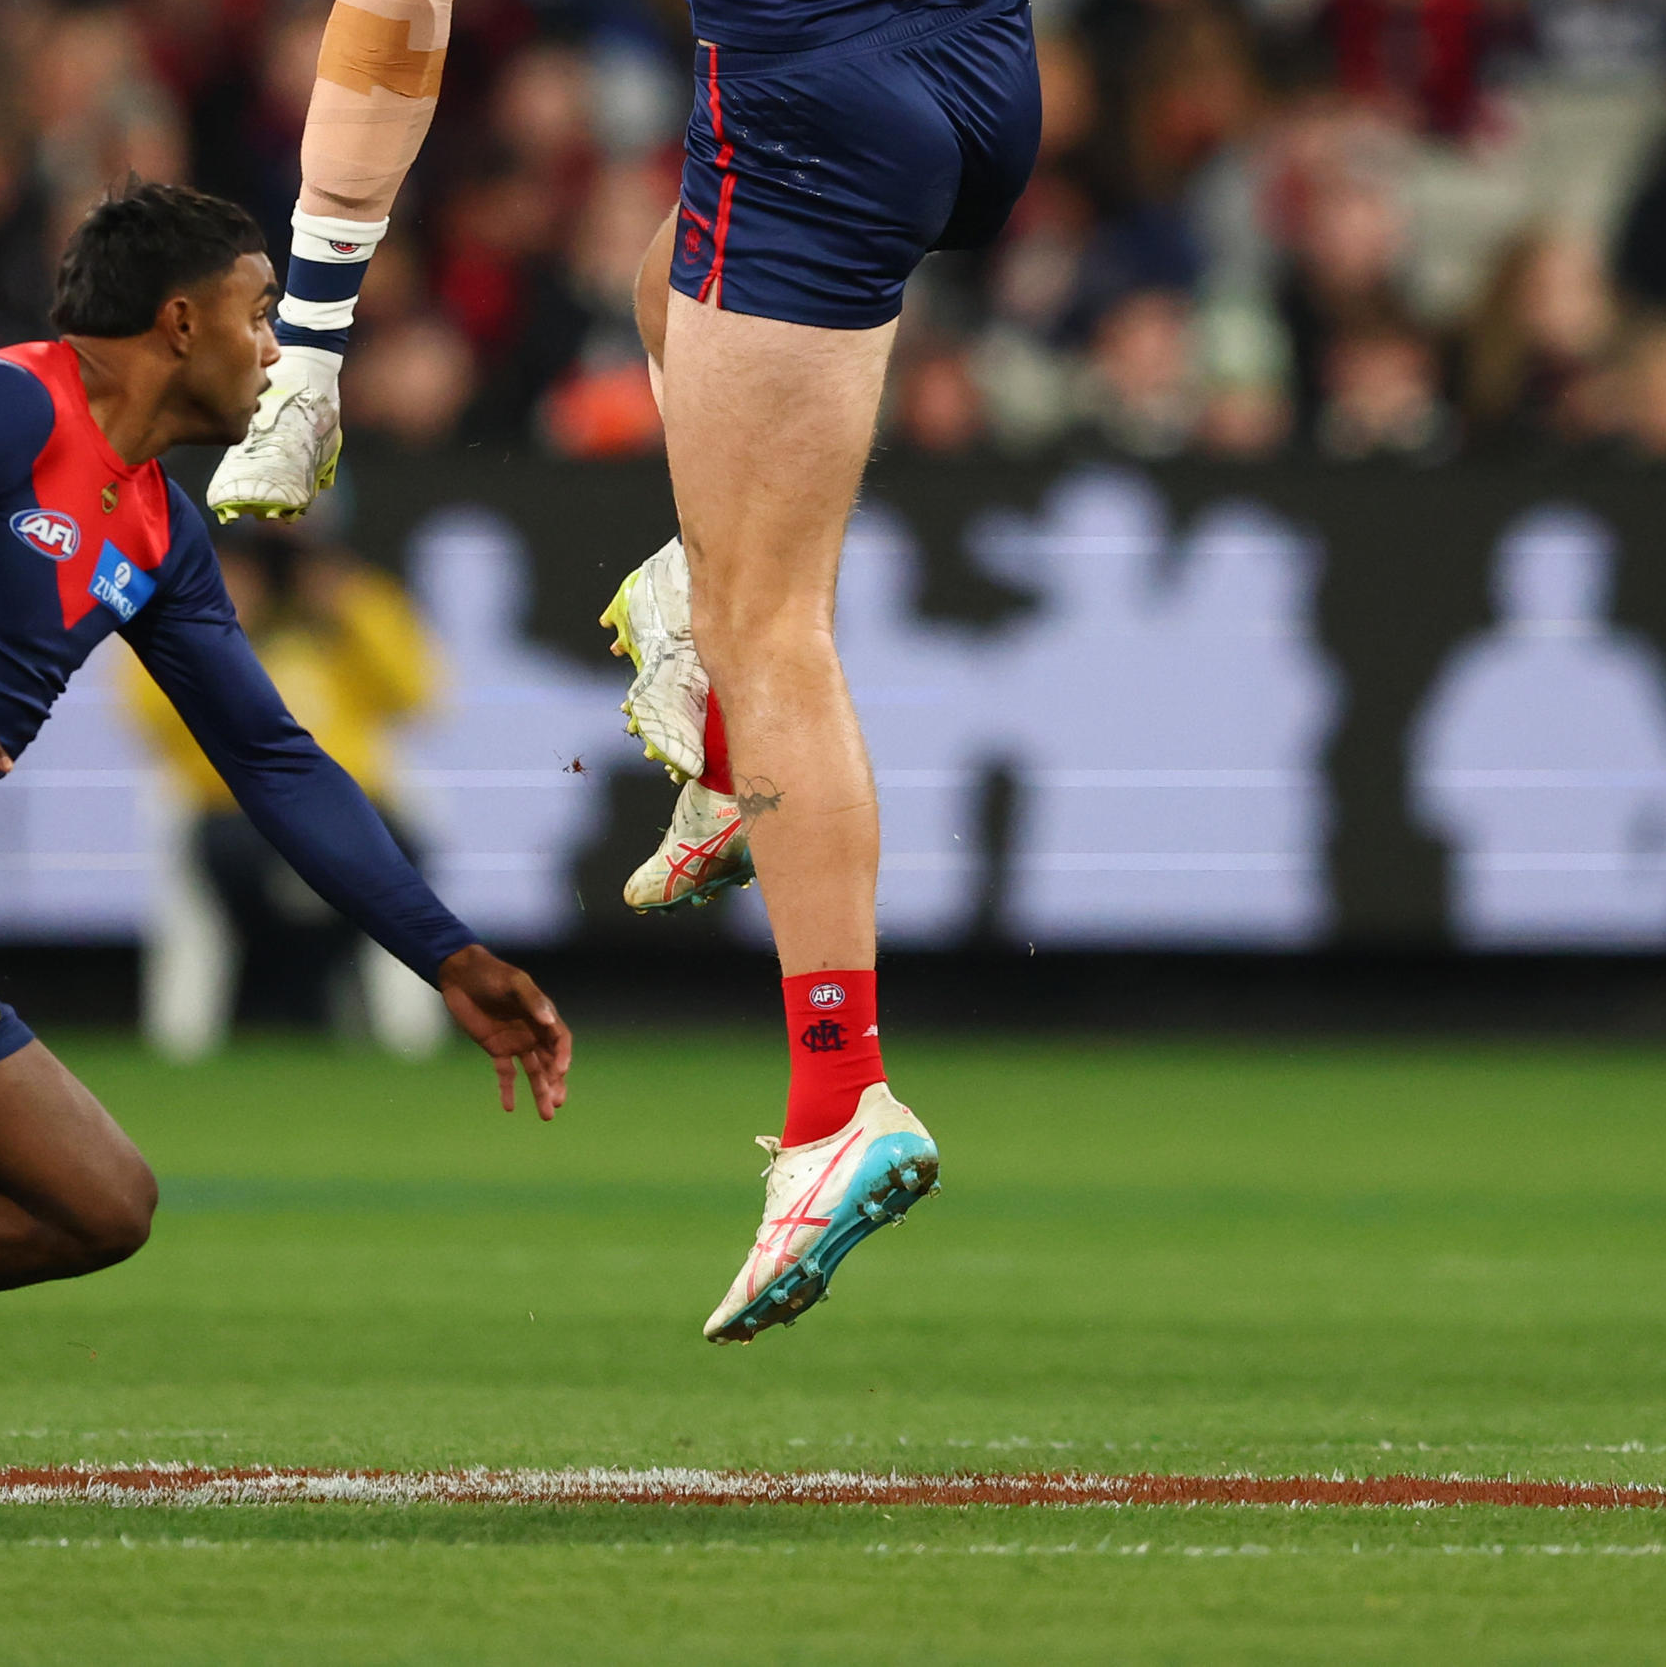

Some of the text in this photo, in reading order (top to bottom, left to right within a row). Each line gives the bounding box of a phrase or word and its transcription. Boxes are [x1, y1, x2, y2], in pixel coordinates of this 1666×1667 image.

[17, 517, 74, 555] AFL
[93, 575, 137, 622] ZURICH
[813, 989, 842, 1003] AFL
